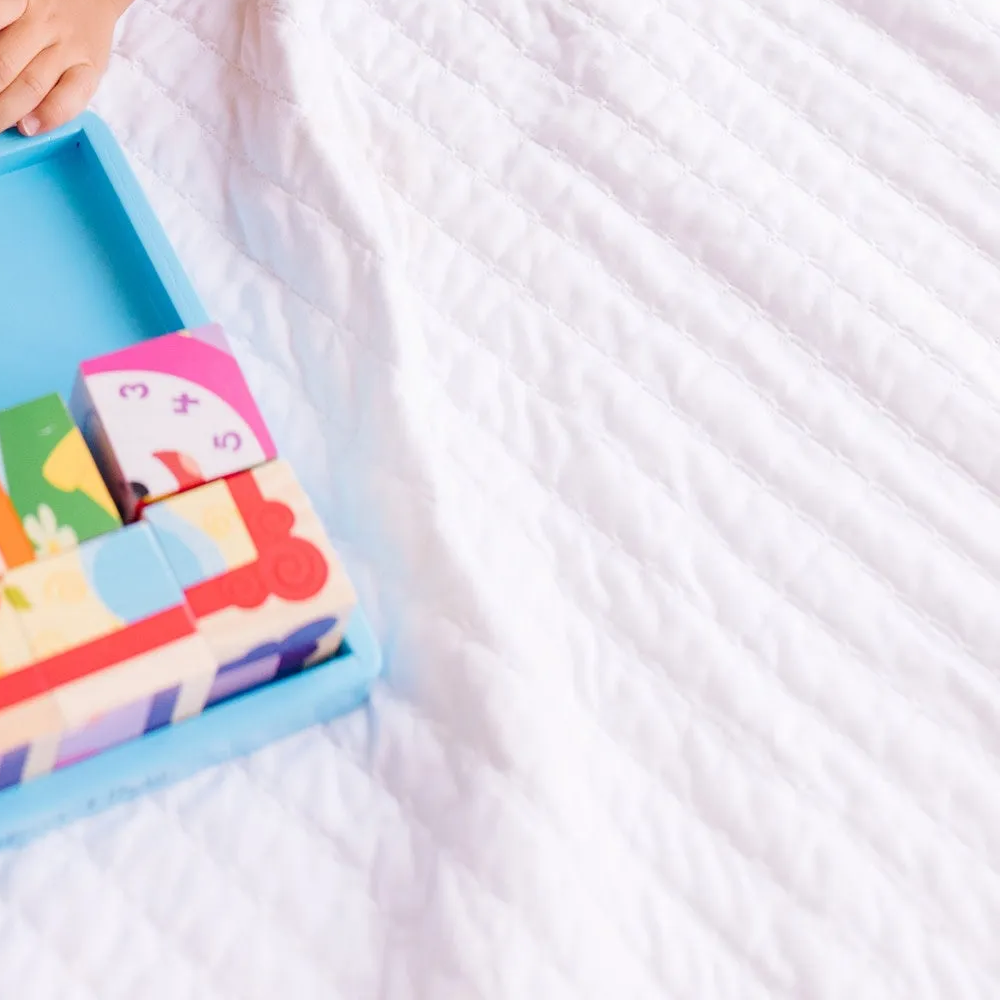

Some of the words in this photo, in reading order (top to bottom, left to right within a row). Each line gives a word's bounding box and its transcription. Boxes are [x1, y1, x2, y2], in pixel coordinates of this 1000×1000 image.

[119, 382, 149, 399] 3
[173, 392, 200, 414] 4
[213, 431, 242, 452] 5
